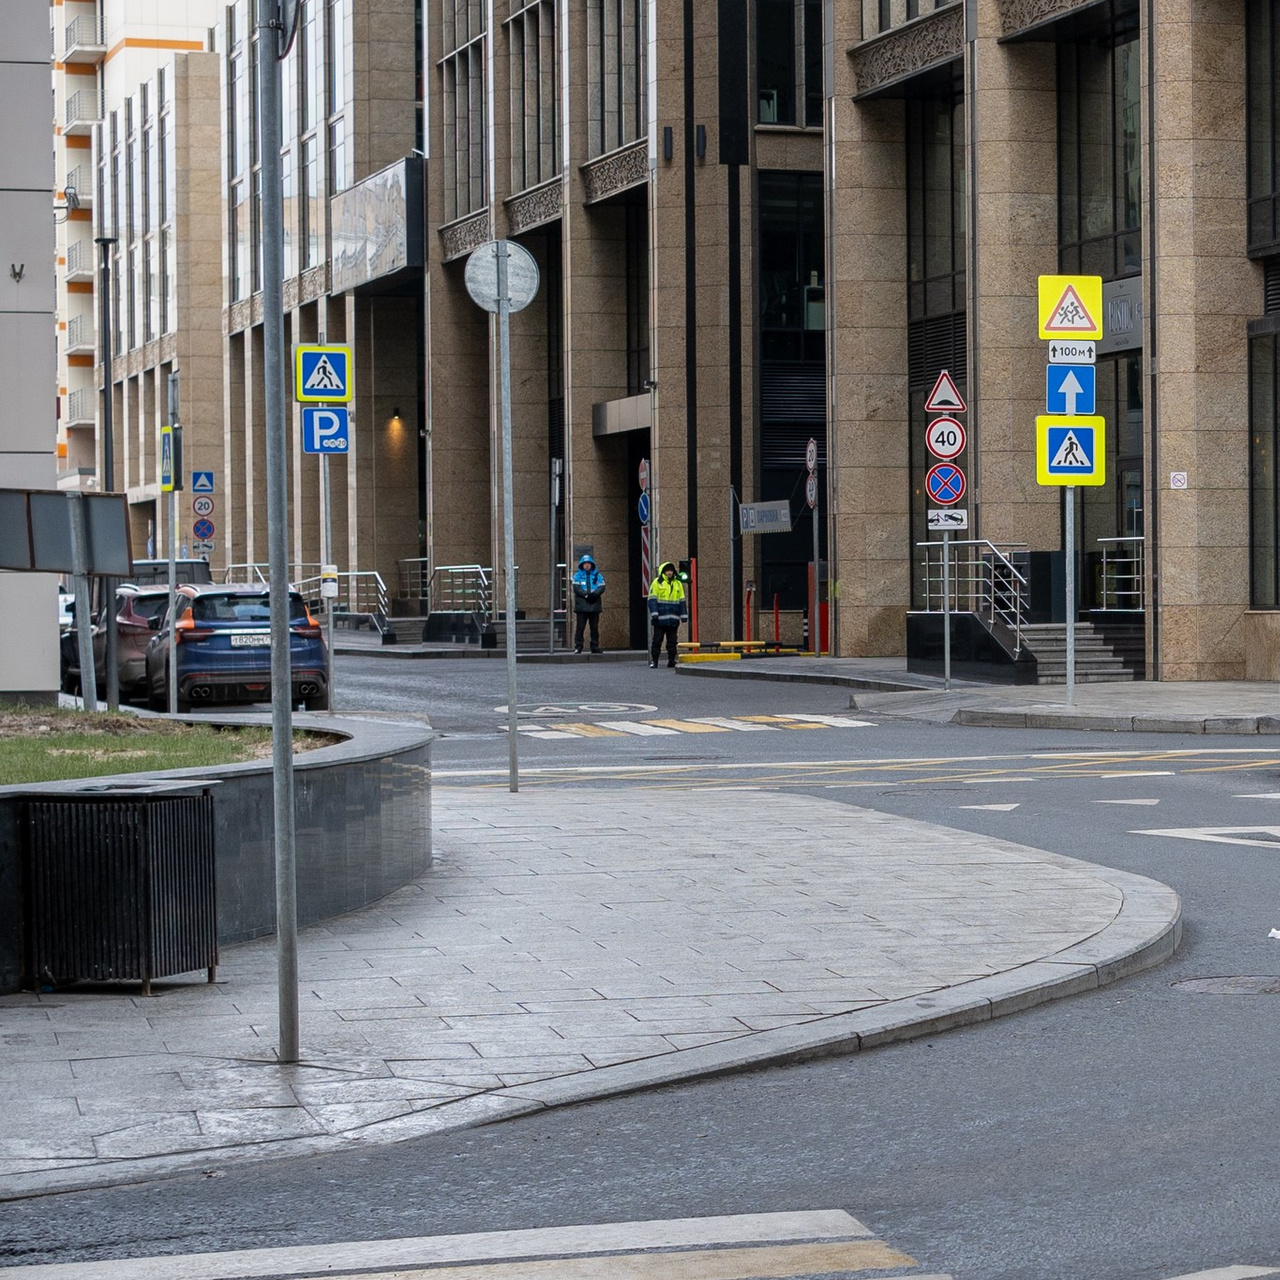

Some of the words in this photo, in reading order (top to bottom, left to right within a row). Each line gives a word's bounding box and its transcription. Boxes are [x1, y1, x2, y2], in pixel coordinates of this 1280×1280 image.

[313, 410, 340, 450] P
[934, 430, 957, 447] 40
[197, 501, 210, 511] 20
